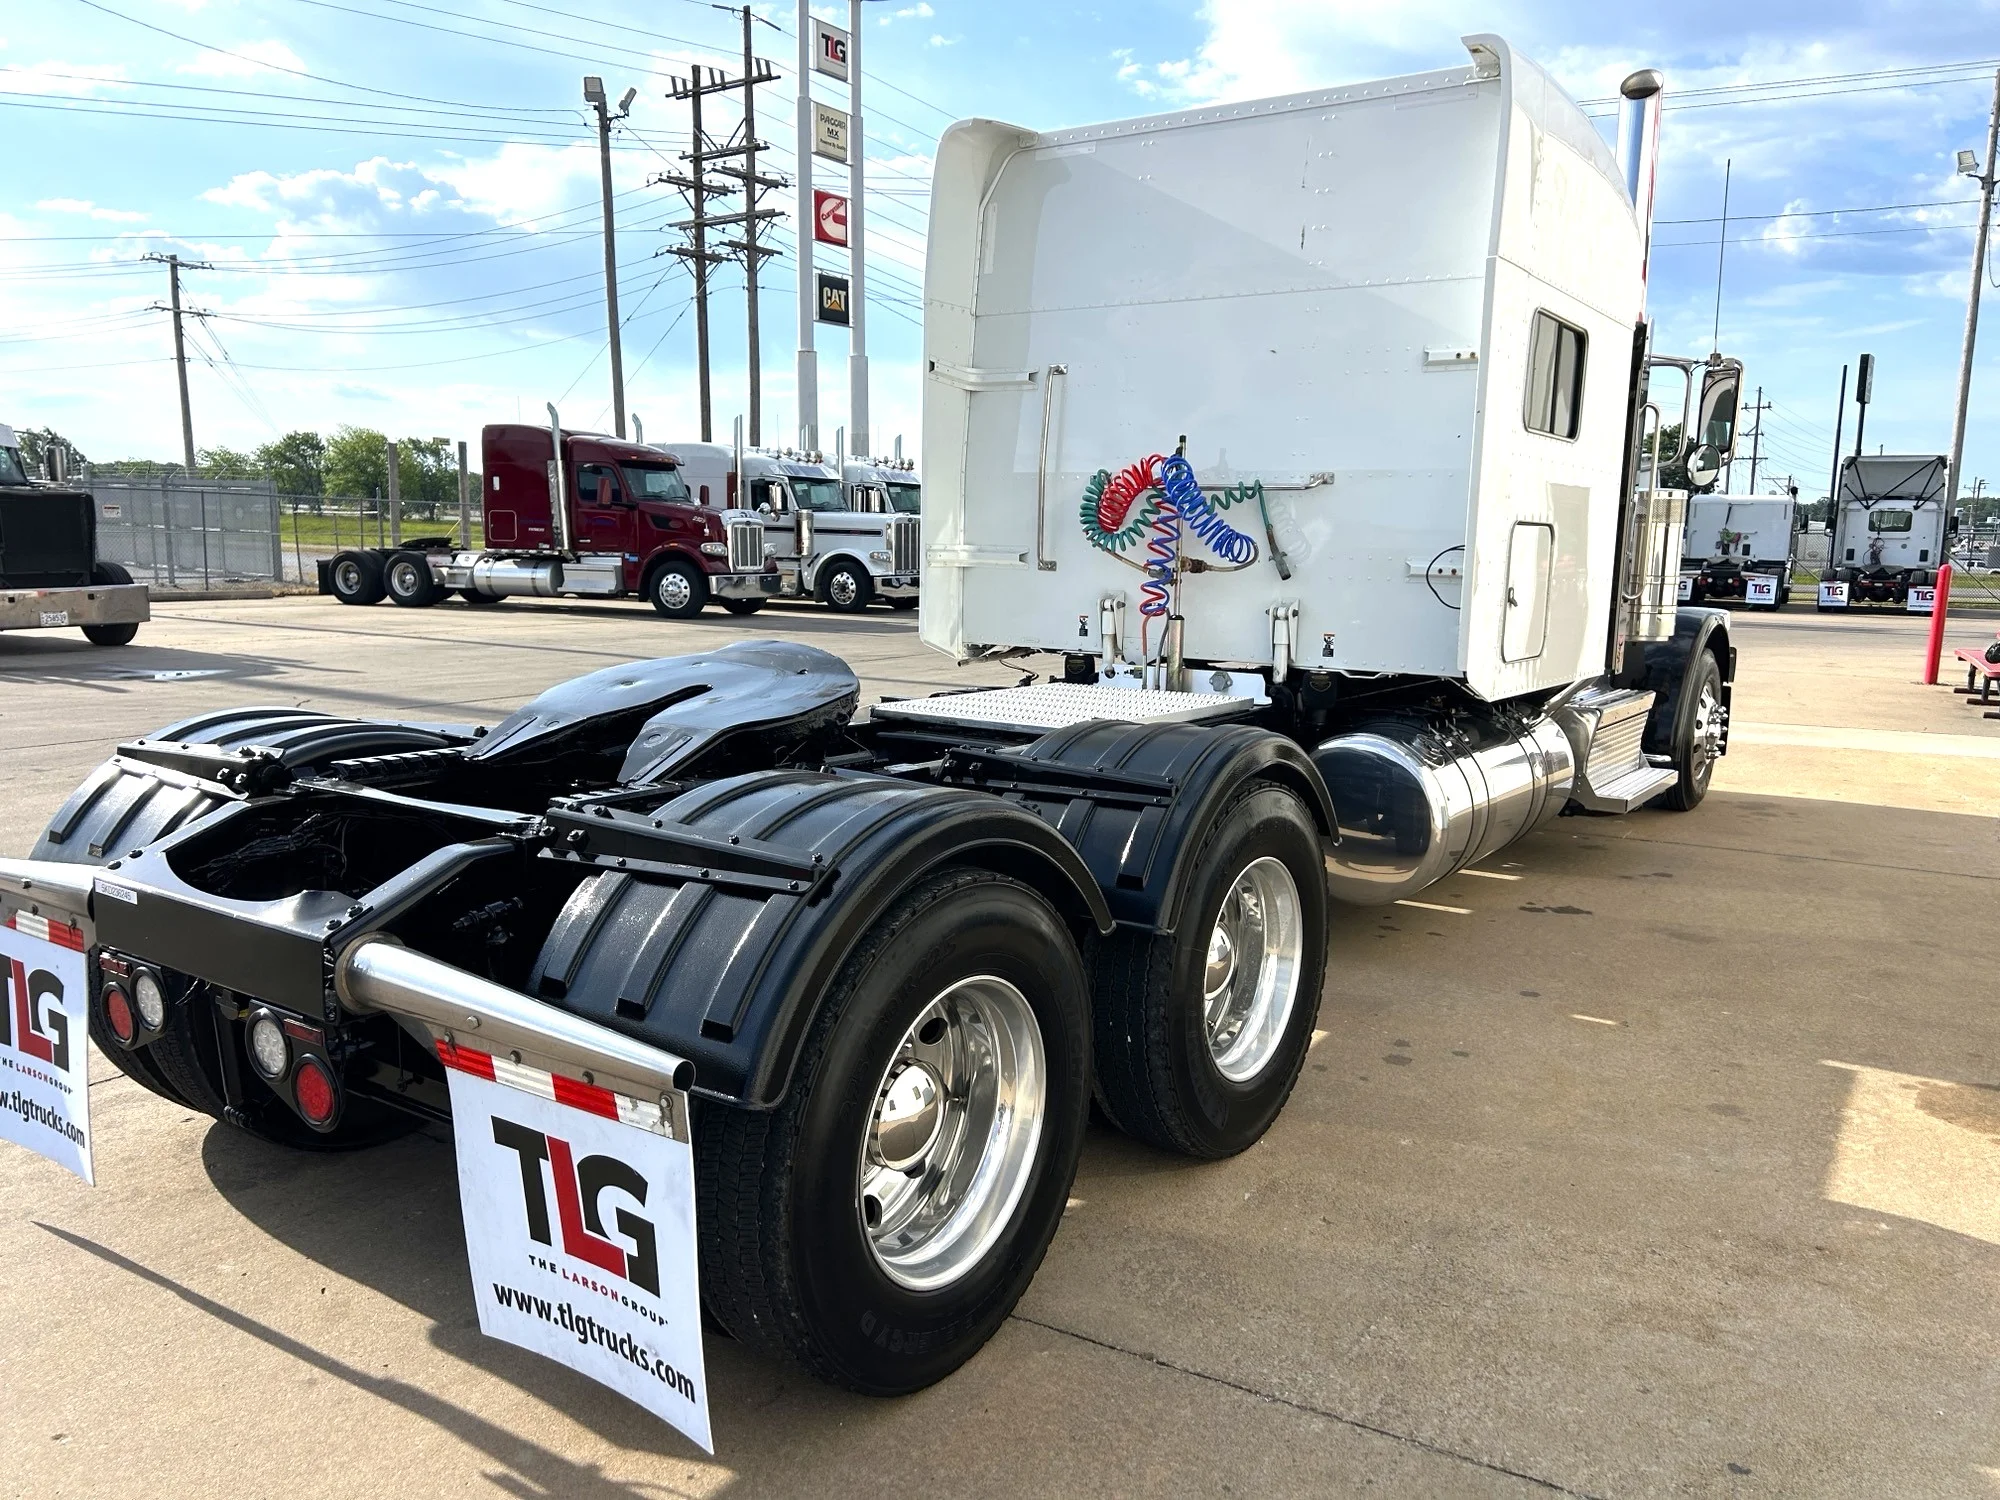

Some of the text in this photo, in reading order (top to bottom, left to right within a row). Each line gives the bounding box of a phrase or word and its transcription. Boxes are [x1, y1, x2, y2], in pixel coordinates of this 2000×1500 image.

[821, 32, 846, 64] TLG
[820, 113, 846, 130] PACCAR
[827, 127, 840, 138] MX
[822, 200, 844, 221] Cummins
[823, 286, 846, 312] CAT
[1752, 584, 1771, 594] TLG
[1824, 586, 1844, 596] TLG
[0, 1056, 13, 1068] HE
[16, 1063, 48, 1082] LARSON
[491, 1115, 660, 1299] TLG
[529, 1255, 664, 1327] THE LARSON GROUP
[492, 1283, 696, 1404] www.tlgtrucks.com
